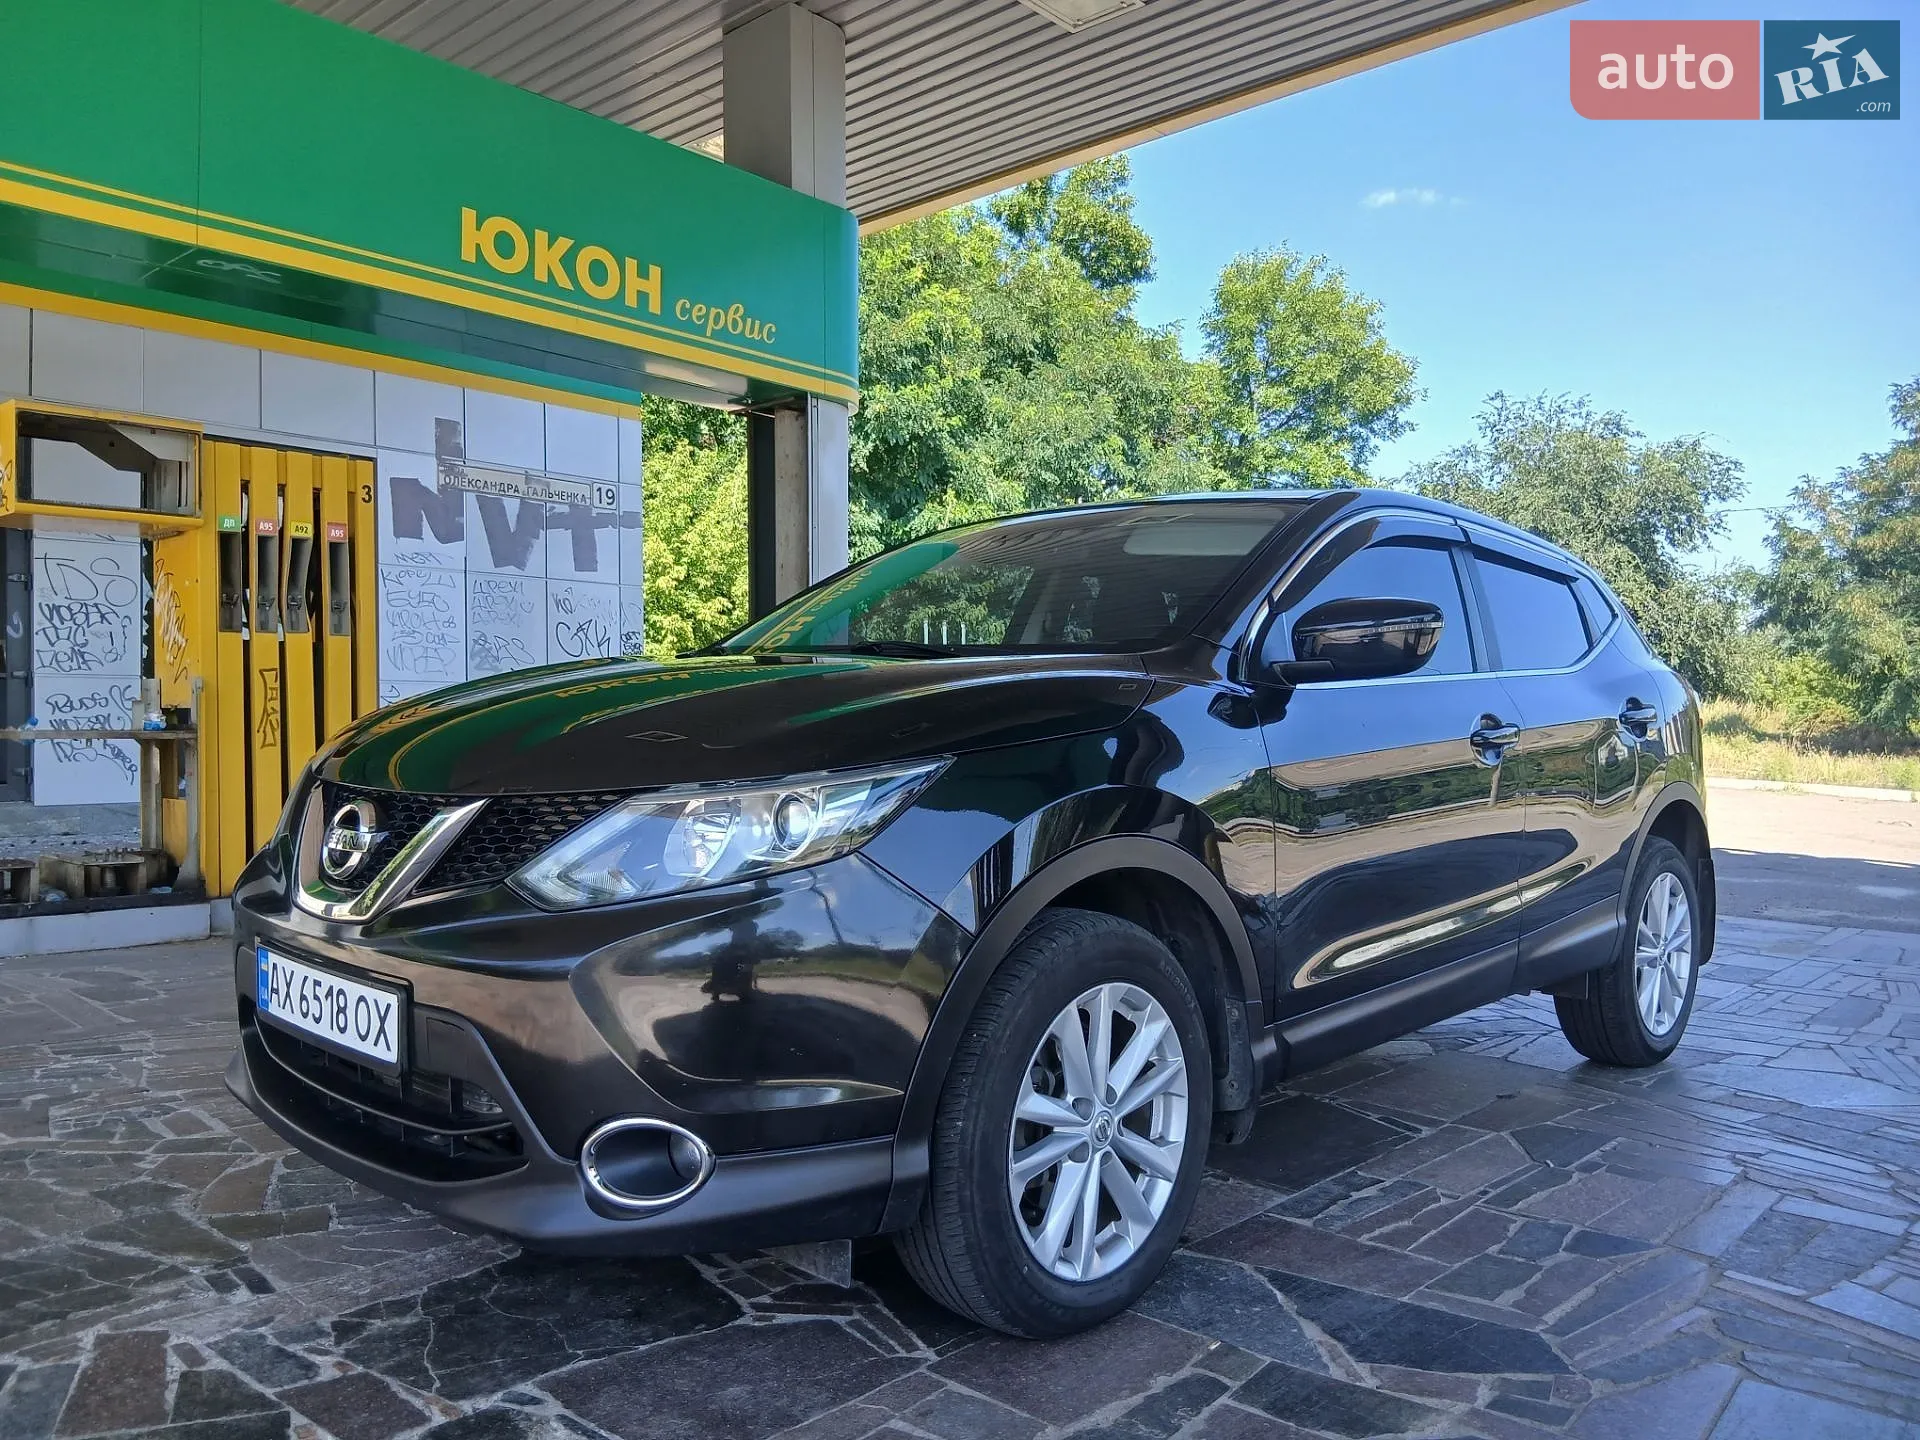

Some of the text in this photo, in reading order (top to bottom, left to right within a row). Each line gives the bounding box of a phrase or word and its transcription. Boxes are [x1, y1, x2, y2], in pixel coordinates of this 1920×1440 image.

[460, 206, 778, 345] ЮКОН сервис
[361, 484, 373, 504] 3
[443, 475, 588, 505] ОЛЕКСАНДРА ГАЛЬЧЕНКА
[595, 486, 616, 506] 19
[223, 518, 236, 528] ДП
[269, 961, 392, 1053] AX 6518 OX
